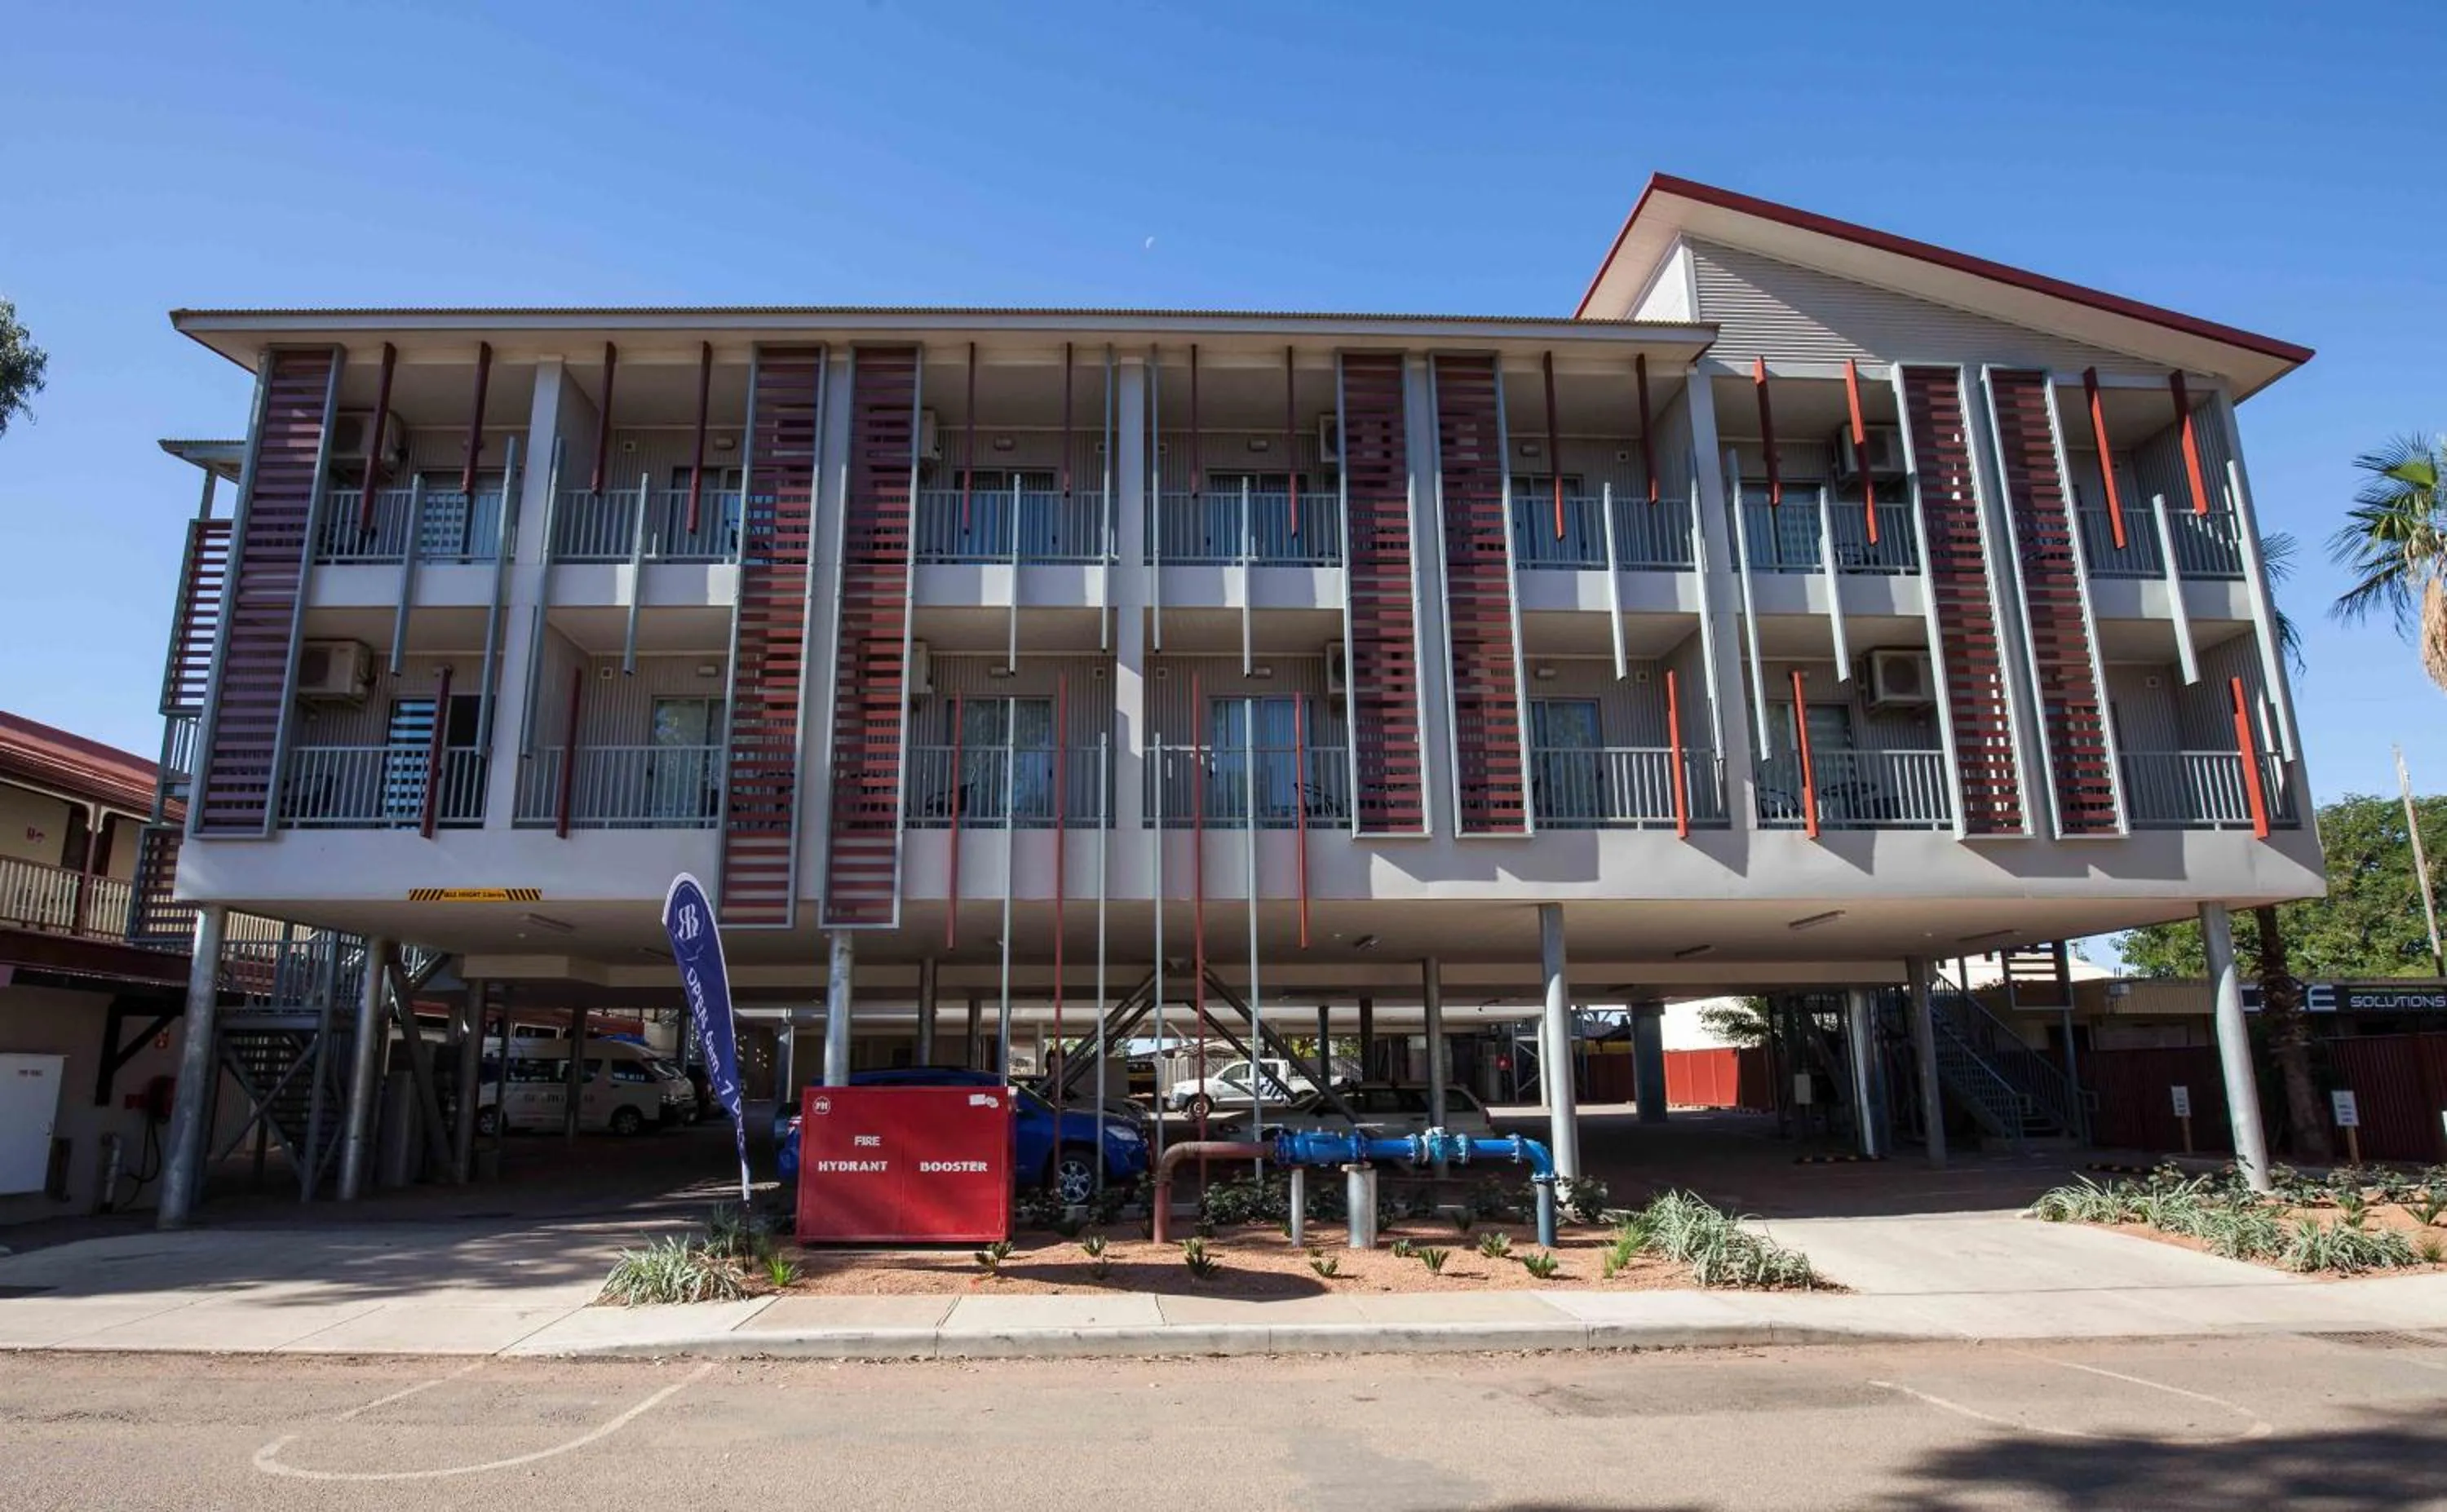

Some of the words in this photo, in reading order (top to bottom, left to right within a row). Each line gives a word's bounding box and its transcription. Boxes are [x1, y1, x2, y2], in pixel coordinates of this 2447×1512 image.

[687, 967, 709, 1030] OPEN
[2350, 995, 2446, 1008] SOLUTIONS
[854, 1135, 881, 1146] FIRE
[818, 1161, 888, 1172] HYDRANT
[919, 1161, 988, 1172] BOOSTER
